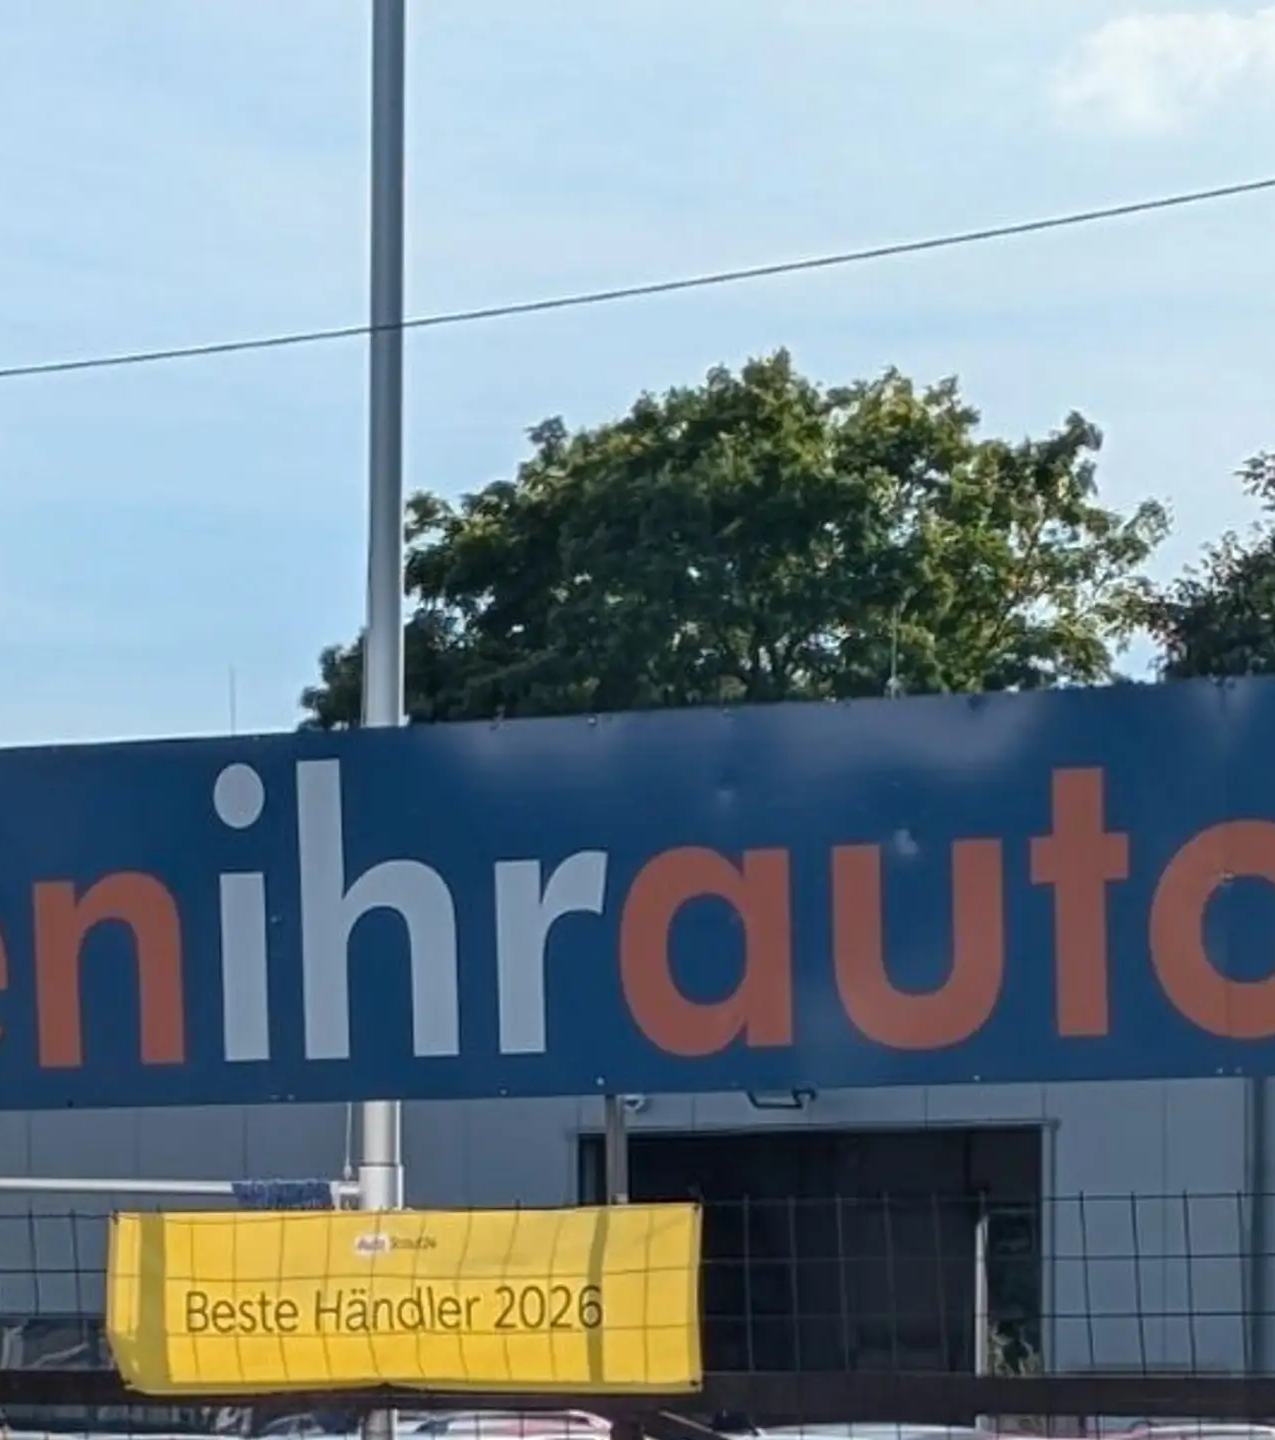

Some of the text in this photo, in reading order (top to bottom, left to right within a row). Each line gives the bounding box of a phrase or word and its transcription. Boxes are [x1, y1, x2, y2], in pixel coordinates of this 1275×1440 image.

[185, 1285, 604, 1333] Beste Händler 2026
